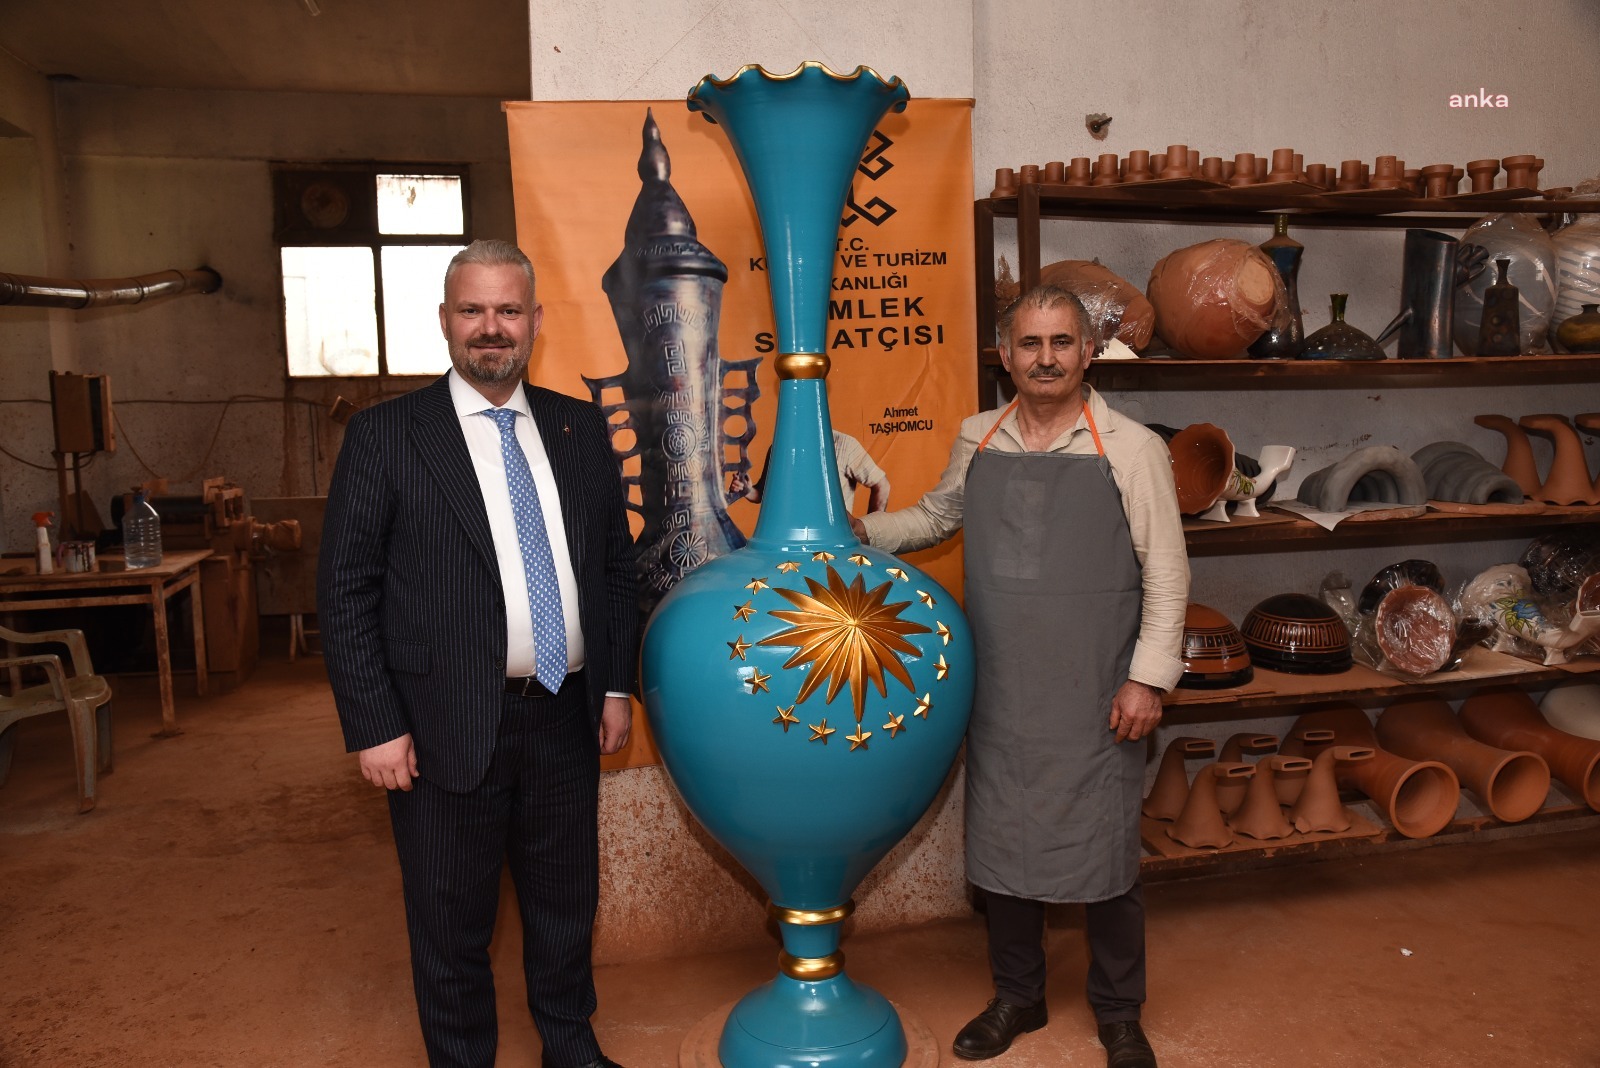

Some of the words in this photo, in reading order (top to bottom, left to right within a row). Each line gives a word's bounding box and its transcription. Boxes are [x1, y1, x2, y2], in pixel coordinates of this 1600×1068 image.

[835, 237, 869, 252] T.C.
[840, 254, 868, 268] VE
[873, 249, 947, 267] TURİZM
[754, 324, 944, 353] SATÇISI
[883, 406, 918, 419] Ahmet
[869, 419, 933, 436] TAŞHOMCU
